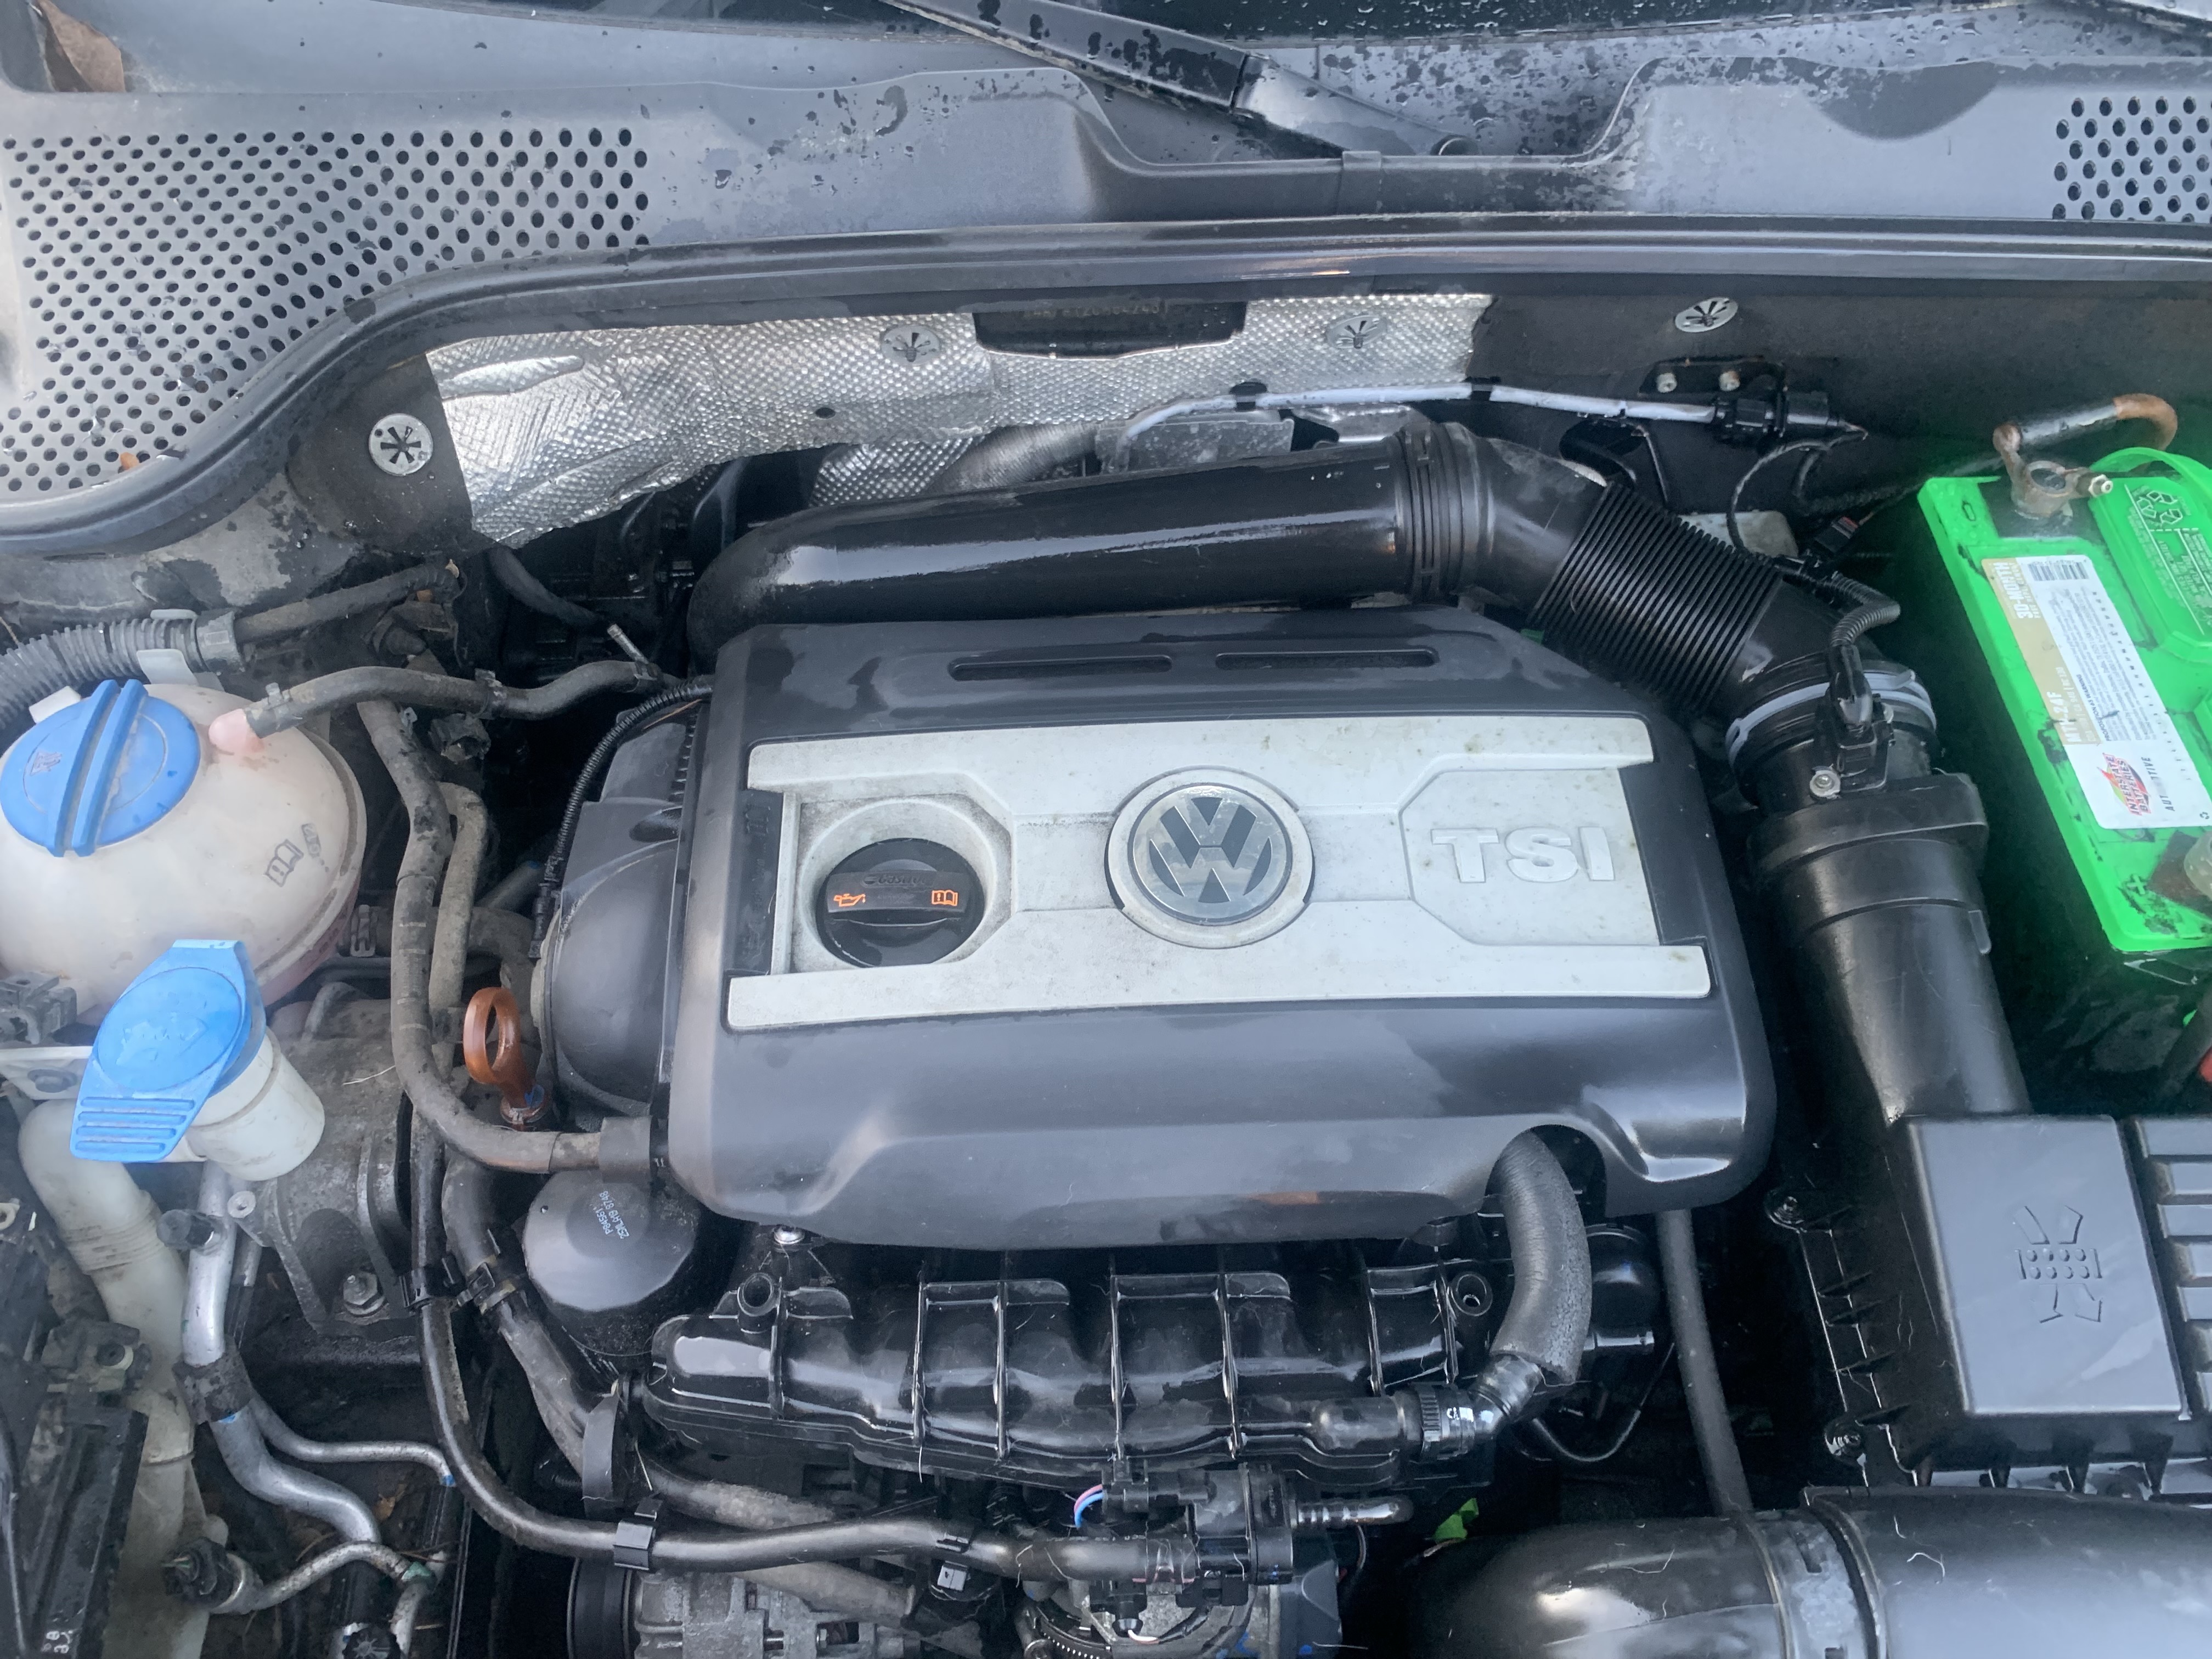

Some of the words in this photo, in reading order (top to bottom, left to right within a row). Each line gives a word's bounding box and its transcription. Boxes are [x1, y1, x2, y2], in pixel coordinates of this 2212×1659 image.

[1993, 562, 2033, 618] 30-MONTH
[2076, 674, 2091, 698] WARNING
[2106, 756, 2140, 815] INTERSTATE
[2117, 760, 2149, 813] BATTERIES
[2141, 757, 2175, 811] AUTTIVE
[1431, 827, 1616, 884] TSI
[596, 1208, 613, 1235] P84561
[599, 1190, 614, 1210] 8748
